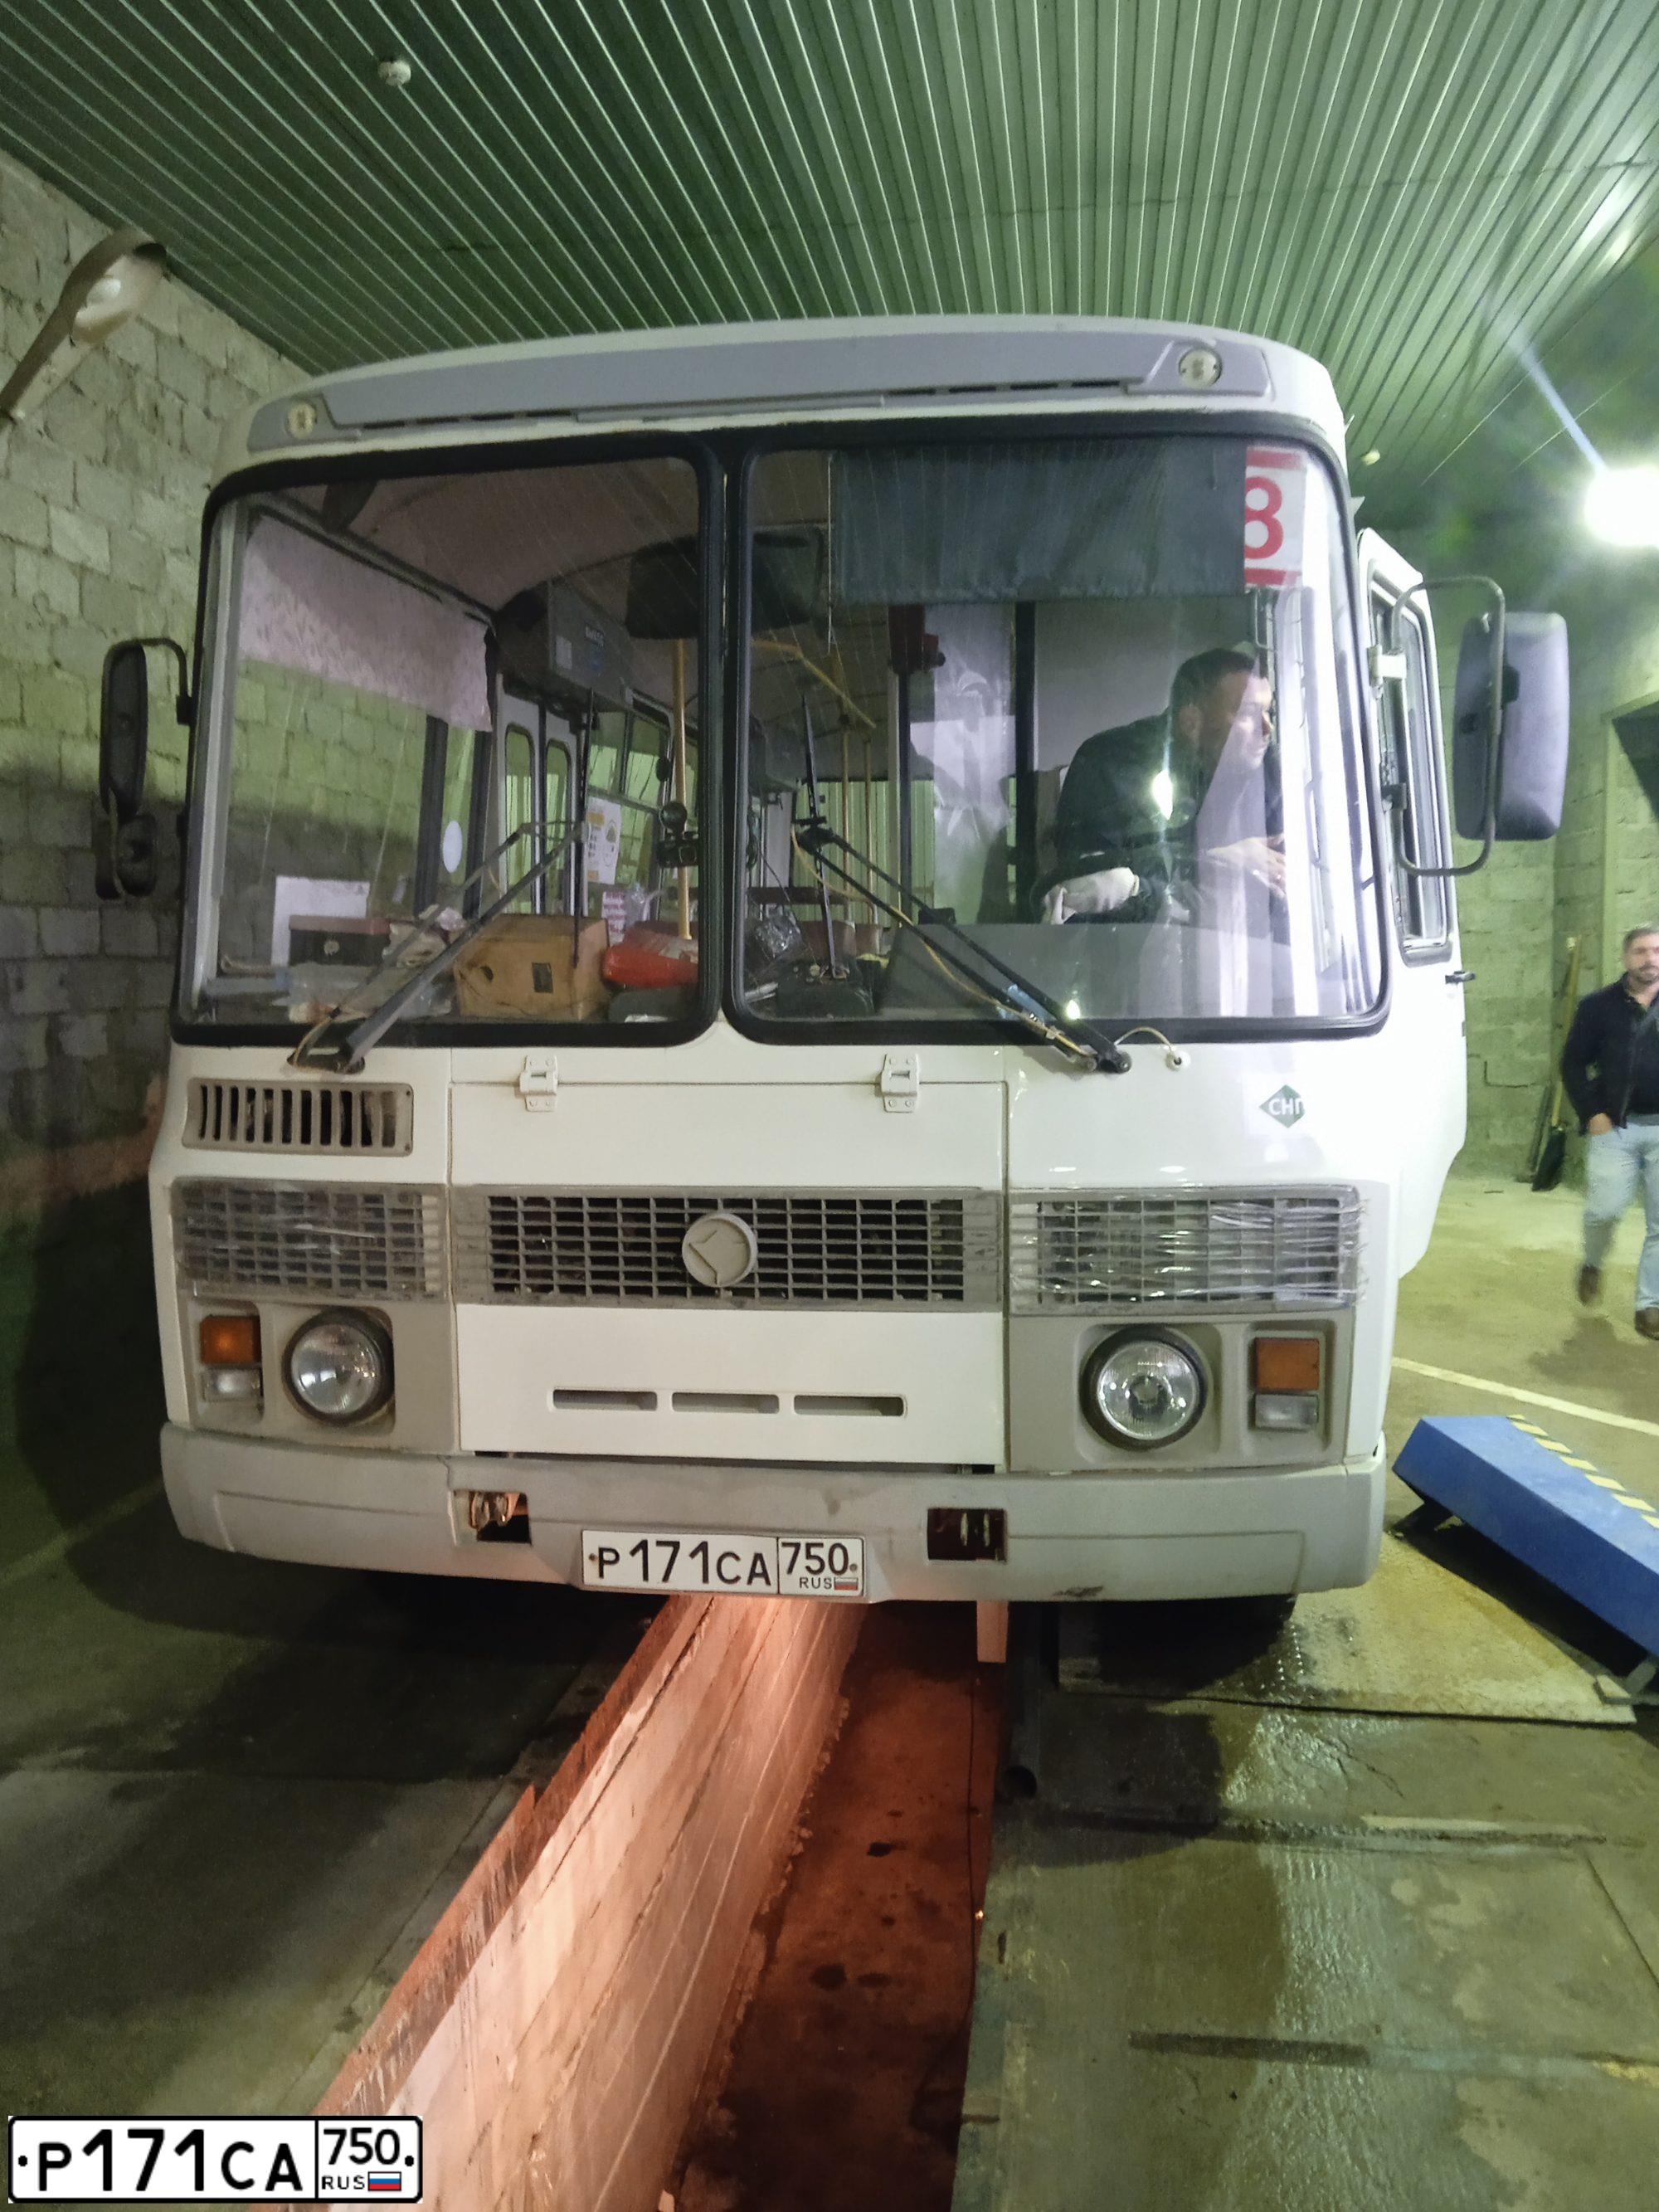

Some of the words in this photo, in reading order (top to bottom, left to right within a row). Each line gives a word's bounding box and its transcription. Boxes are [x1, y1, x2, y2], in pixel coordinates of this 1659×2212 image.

[597, 1538, 772, 1586] Р171СА
[781, 1542, 849, 1576] 750
[799, 1576, 833, 1591] RUS
